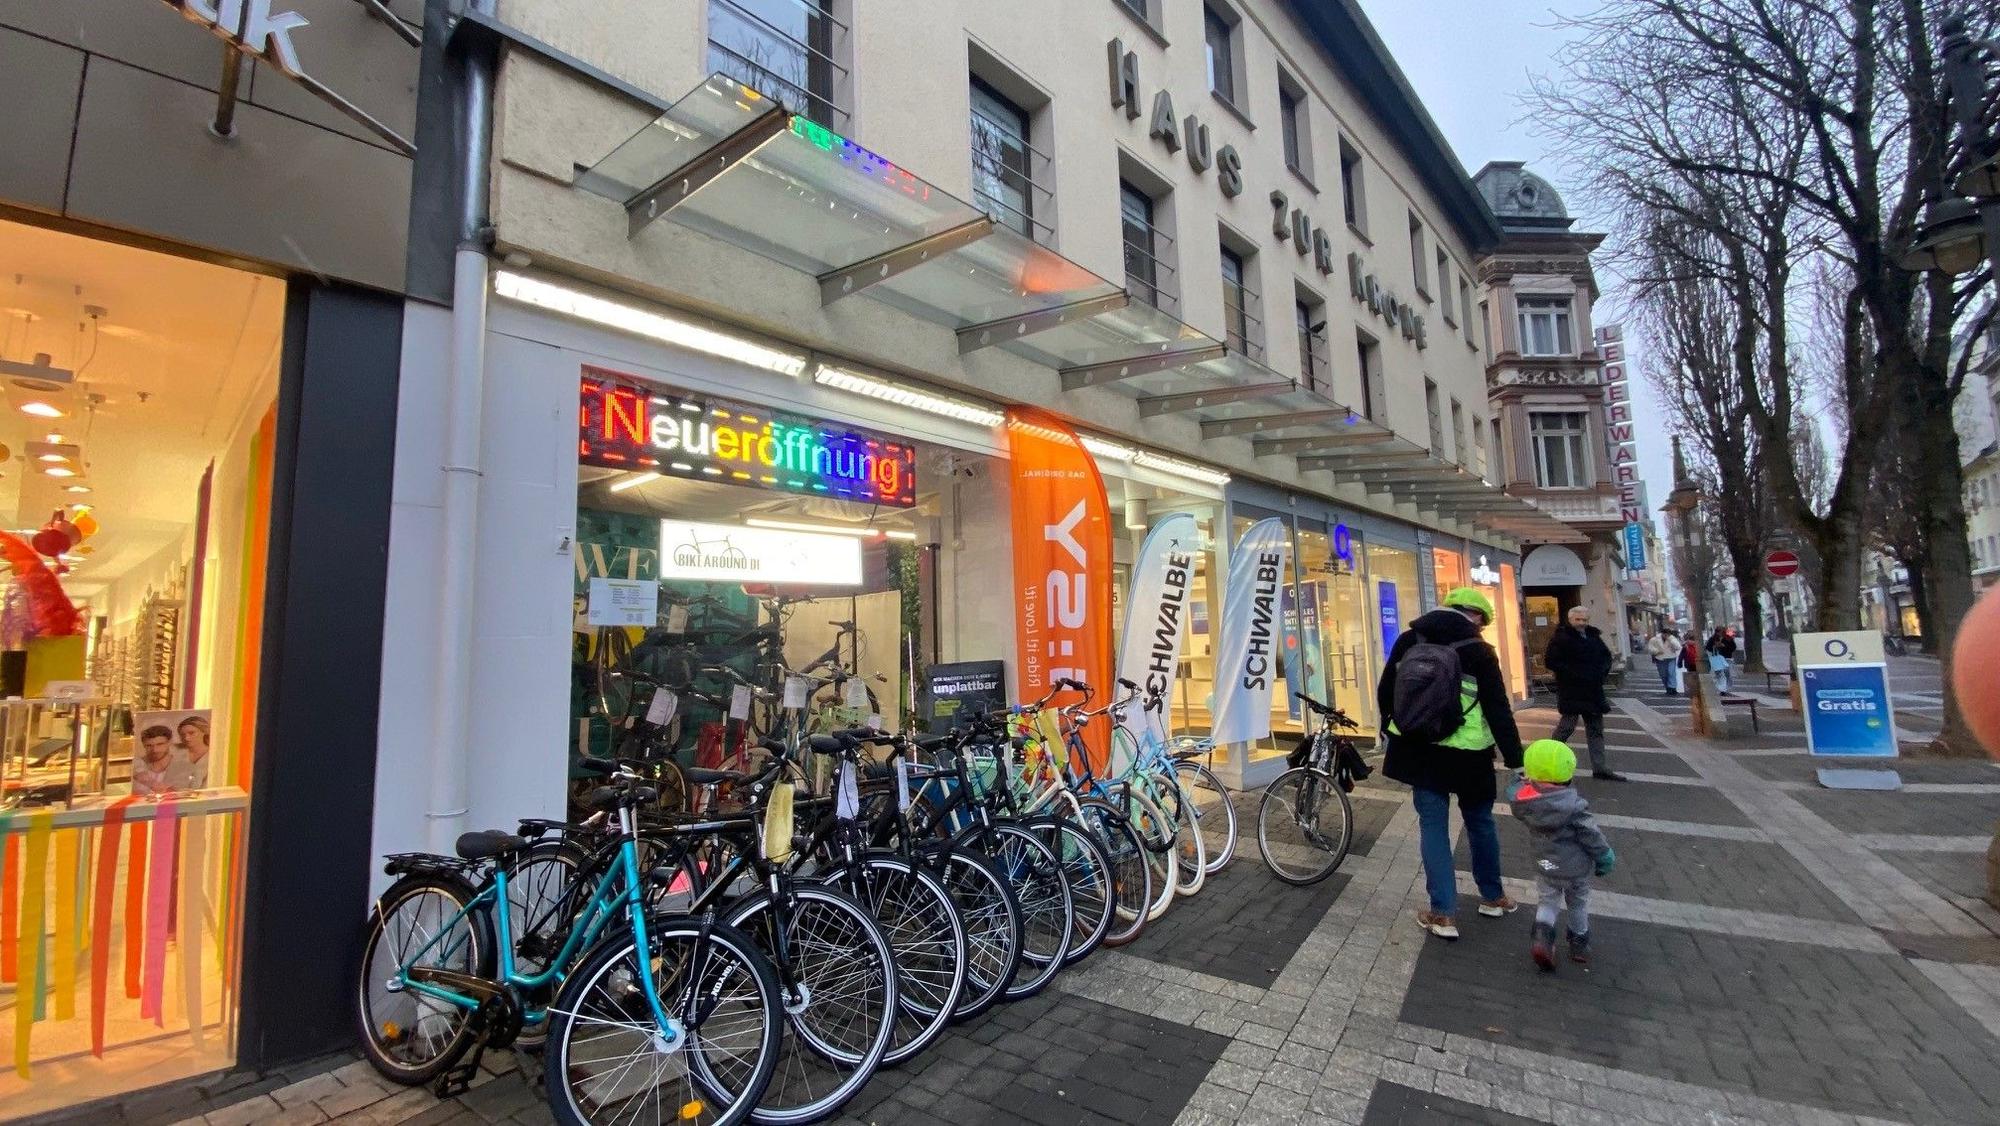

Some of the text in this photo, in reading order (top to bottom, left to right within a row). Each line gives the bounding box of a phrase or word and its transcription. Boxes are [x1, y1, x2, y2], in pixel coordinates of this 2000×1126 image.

[1107, 37, 1428, 350] HAUS ZUR KRONE
[603, 391, 900, 494] Neueröffnung
[1602, 328, 1638, 523] LEDERWAREN
[704, 555, 747, 570] AROUND
[1243, 553, 1280, 691] SCHWALBE
[932, 681, 998, 695] unplattbar
[1143, 551, 1191, 715] SCHWALBE
[1817, 699, 1877, 711] Gratis
